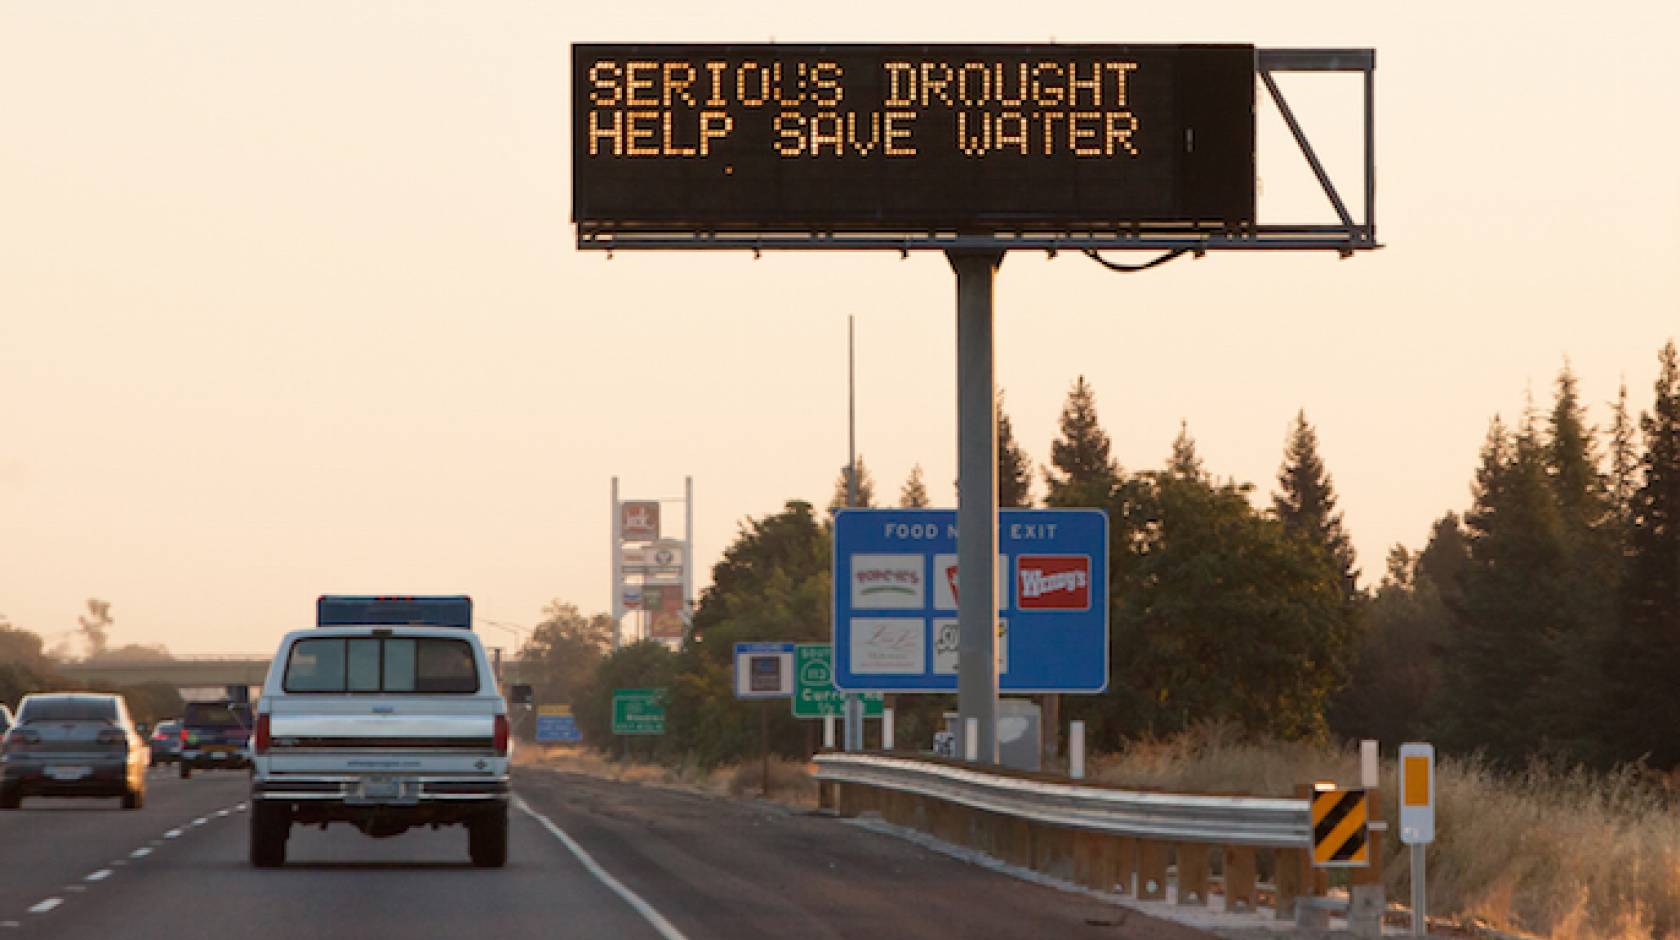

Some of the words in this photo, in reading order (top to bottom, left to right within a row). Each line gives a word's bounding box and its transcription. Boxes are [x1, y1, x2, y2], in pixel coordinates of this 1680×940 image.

[589, 61, 844, 107] SERIOUS
[885, 61, 1138, 107] DROUGHT
[589, 111, 733, 157] HELP
[773, 111, 917, 157] SAVE
[957, 111, 1138, 157] WATER
[884, 523, 939, 540] FOOD
[1010, 523, 1057, 540] EXIT
